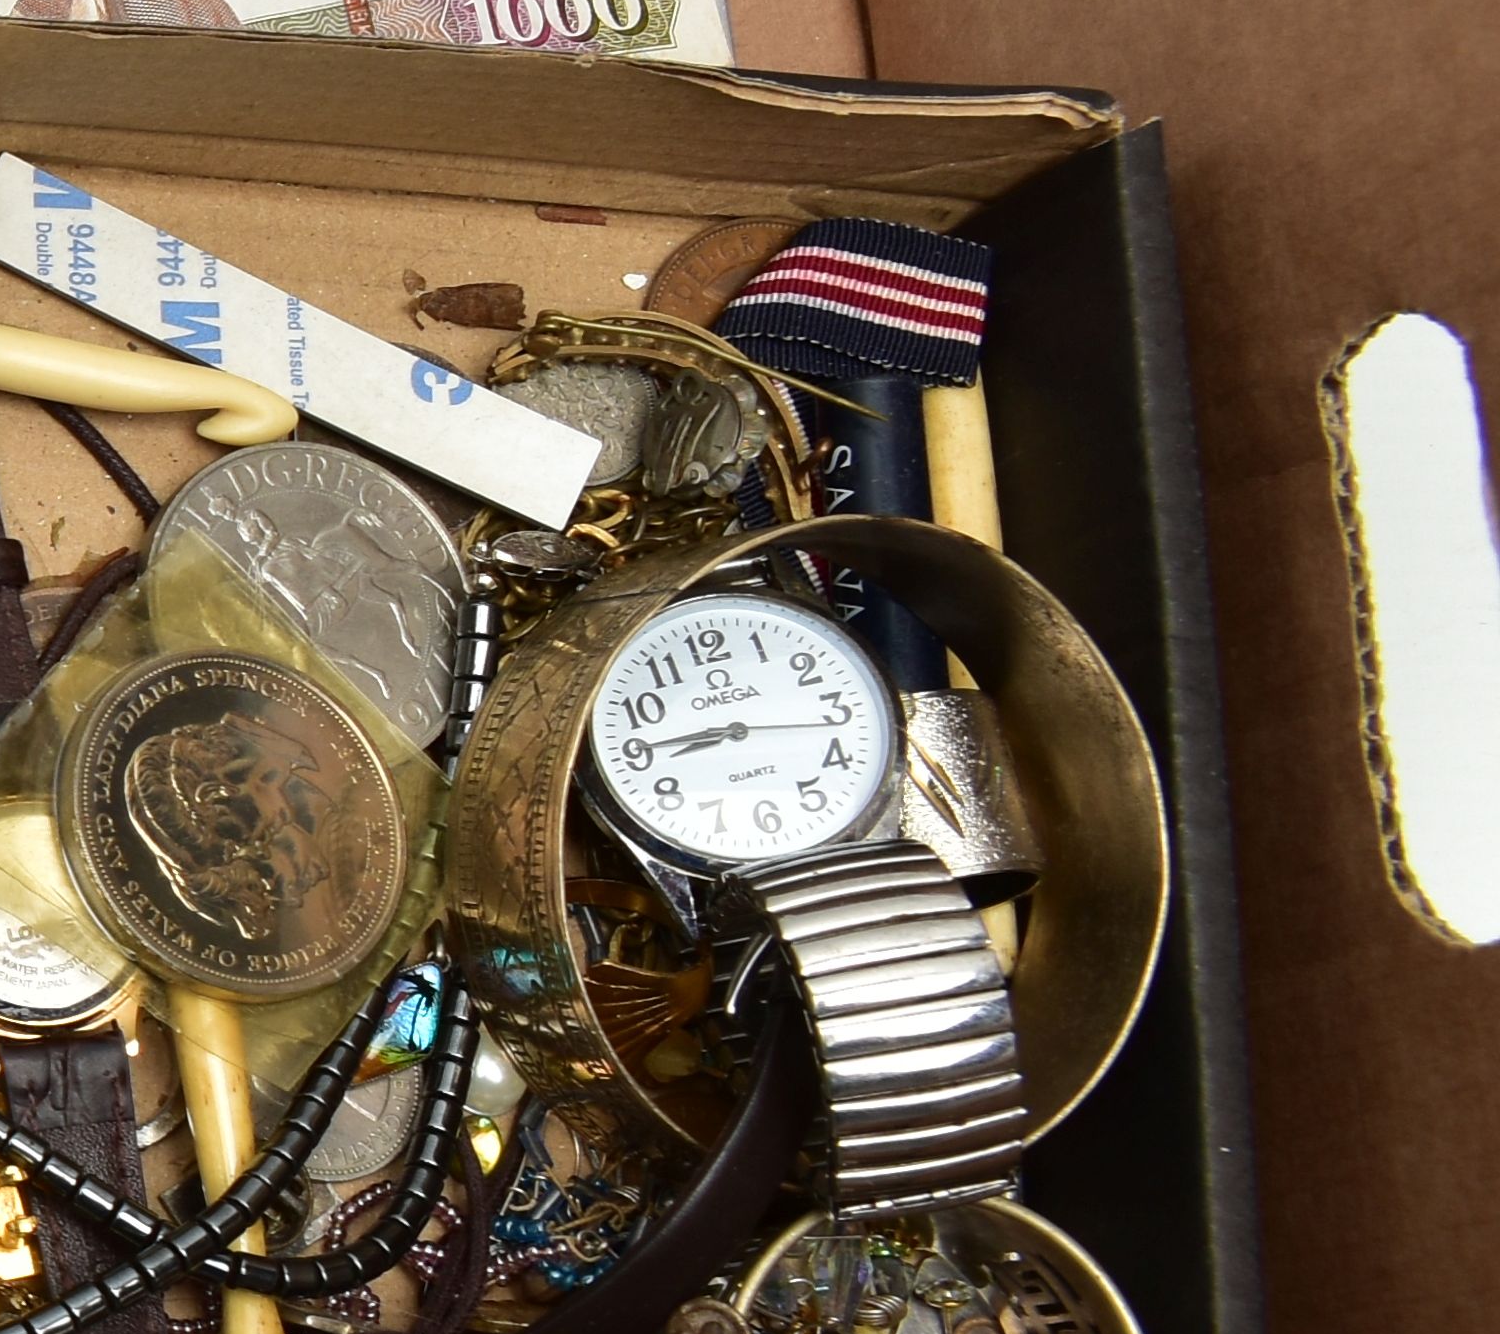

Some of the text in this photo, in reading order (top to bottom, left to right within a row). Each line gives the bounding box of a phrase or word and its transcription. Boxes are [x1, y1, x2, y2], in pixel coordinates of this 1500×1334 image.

[35, 222, 53, 276] Double
[289, 338, 306, 387] Tissue
[684, 629, 732, 666] 12
[749, 631, 770, 663] 1
[646, 652, 684, 689] 11
[790, 652, 823, 686] 2
[621, 691, 666, 729] 10
[691, 685, 762, 710] OMEGA
[819, 691, 852, 726] 3
[93, 668, 309, 804] LADY DIANA SPENCER
[622, 737, 655, 771] 9
[821, 737, 853, 771] 4
[728, 764, 778, 783] QUARTZ
[653, 776, 685, 811] 8
[796, 776, 828, 813] 5
[698, 798, 728, 834] 7
[752, 799, 782, 834] 6
[96, 813, 130, 873] AND
[122, 880, 197, 953] WALES
[201, 944, 236, 968] OF
